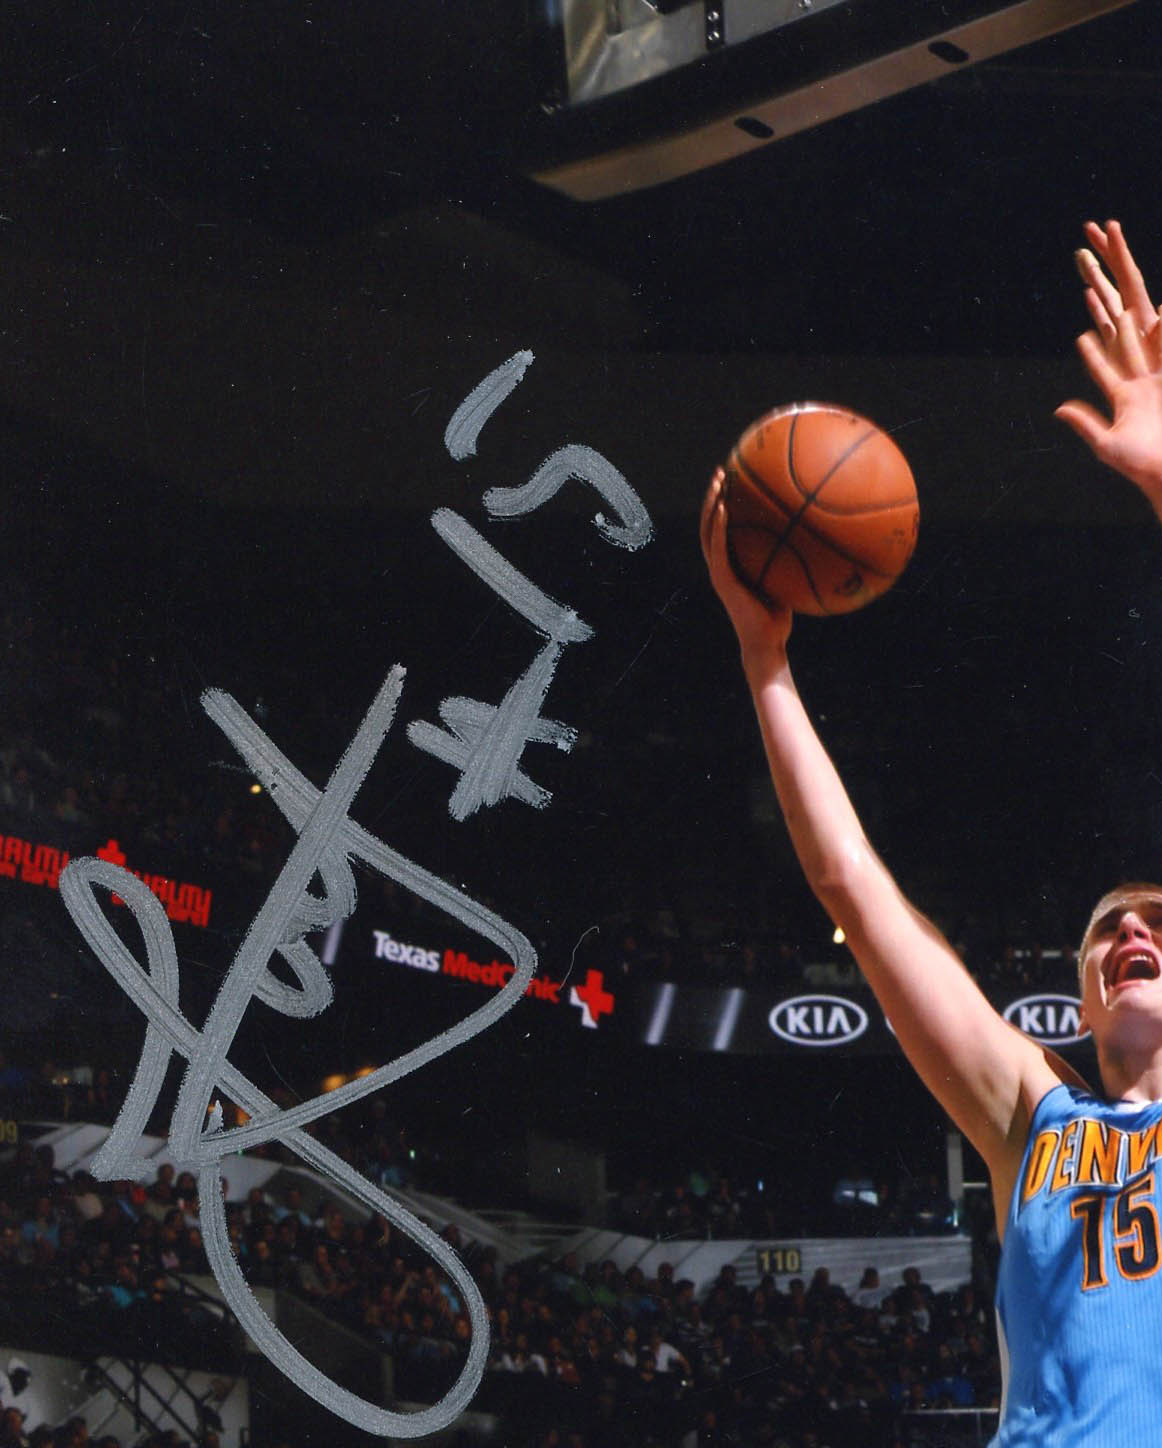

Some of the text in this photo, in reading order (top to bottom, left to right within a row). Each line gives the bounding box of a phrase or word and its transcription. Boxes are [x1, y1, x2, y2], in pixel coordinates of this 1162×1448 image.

[373, 930, 561, 1004] Texas MedCnic
[787, 1005, 852, 1035] KIA
[758, 1249, 801, 1273] 110
